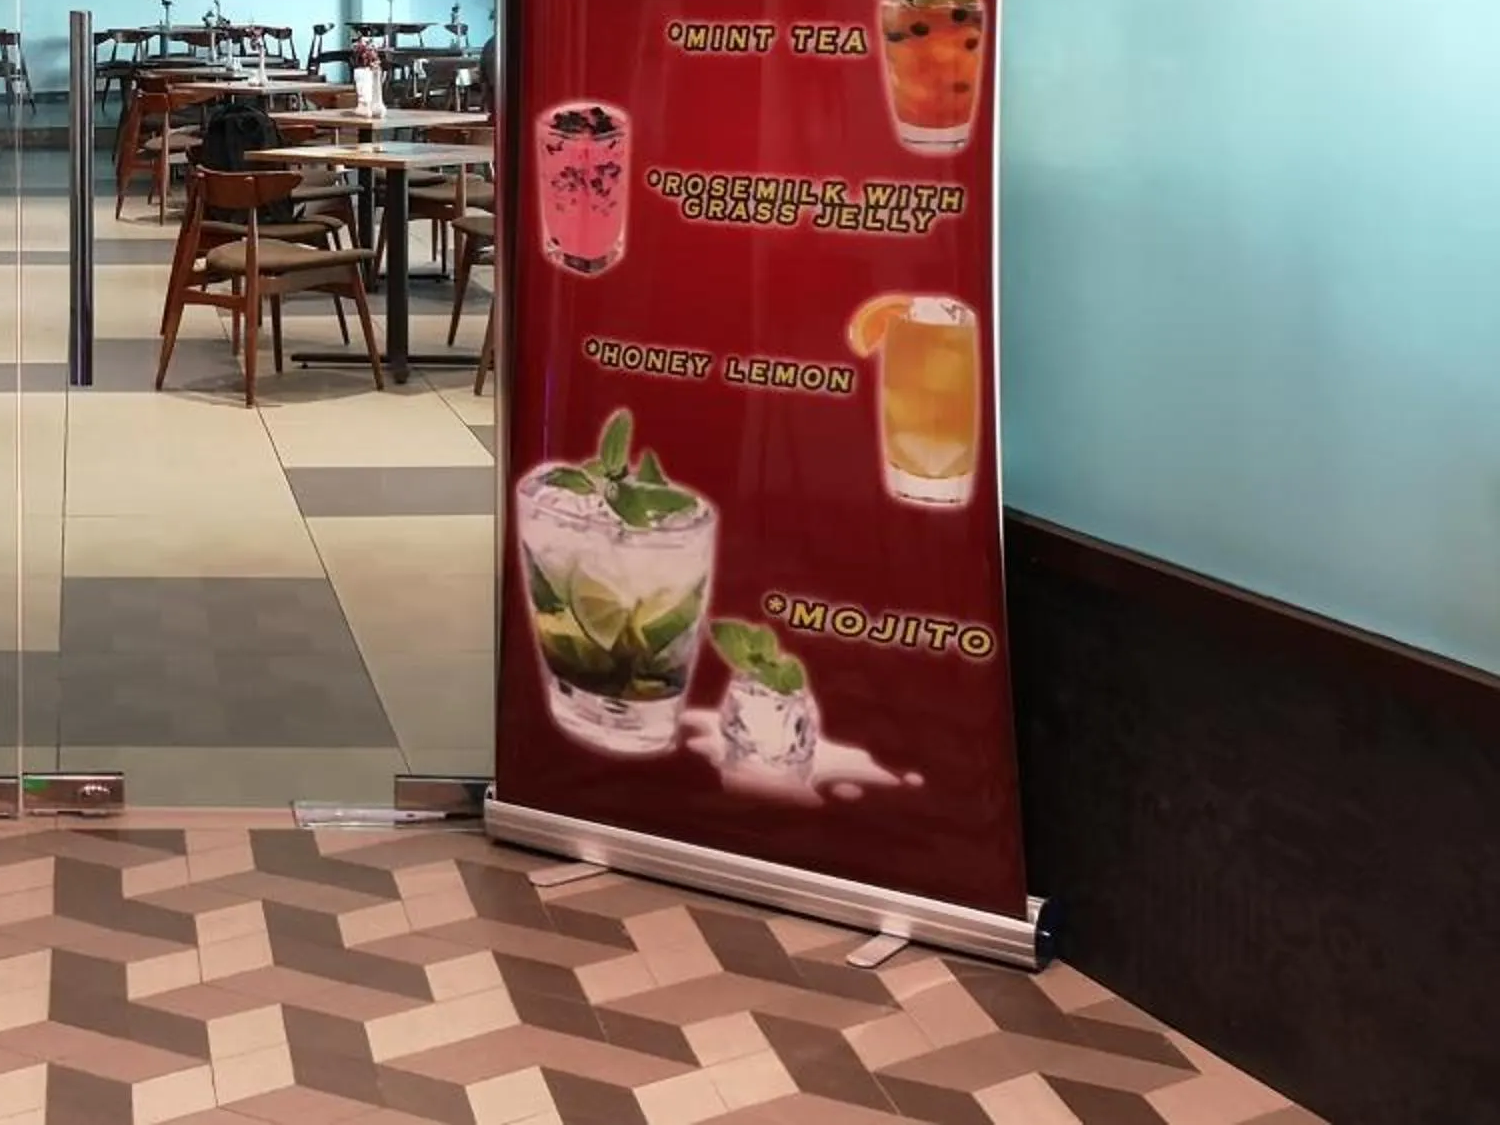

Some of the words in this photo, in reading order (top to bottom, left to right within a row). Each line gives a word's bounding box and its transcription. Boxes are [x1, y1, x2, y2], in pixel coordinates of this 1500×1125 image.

[792, 26, 867, 54] TEA
[865, 185, 964, 212] WITH
[683, 198, 798, 224] GRASS
[815, 204, 937, 233] JELLY
[726, 358, 854, 393] LEMON
